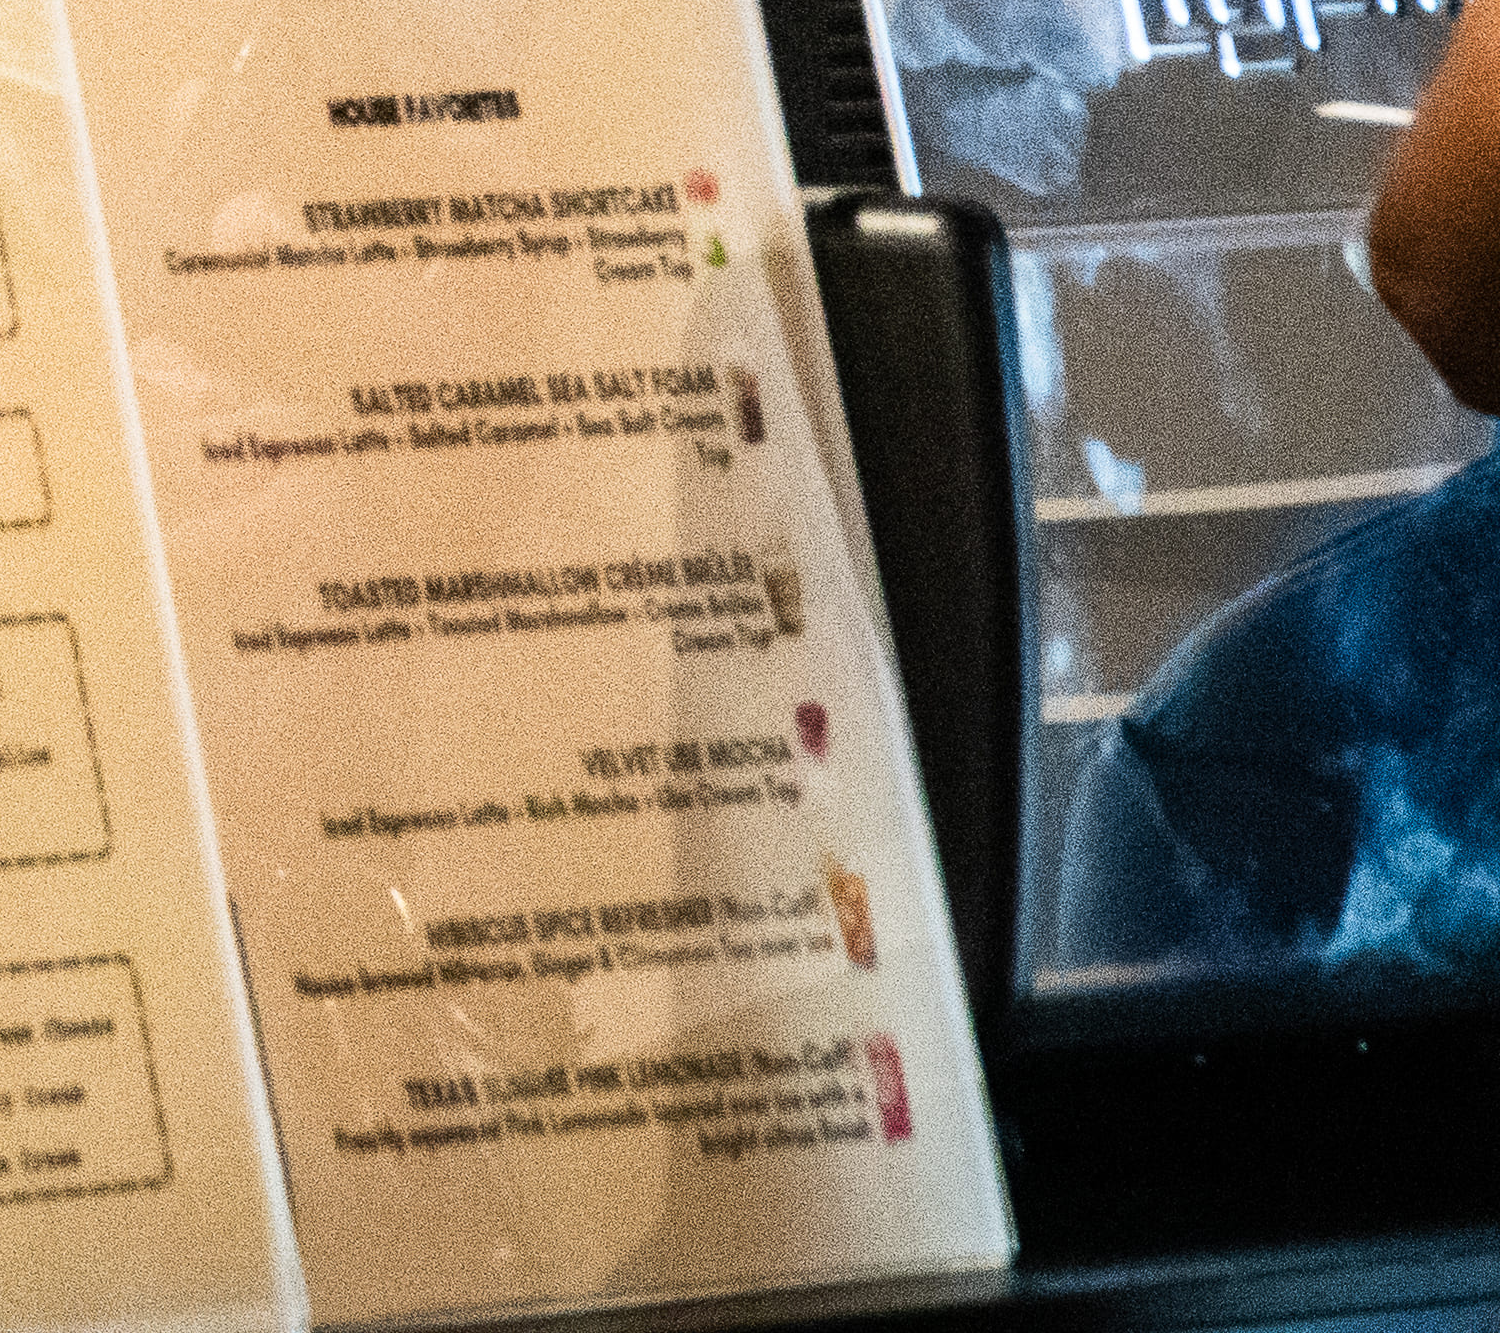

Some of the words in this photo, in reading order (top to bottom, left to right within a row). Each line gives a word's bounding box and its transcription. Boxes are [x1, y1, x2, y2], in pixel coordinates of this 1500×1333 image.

[328, 96, 400, 127] HOUSE
[406, 90, 521, 123] FAVORITES
[303, 197, 442, 233] STRAWBERRY
[449, 191, 546, 224] MATCHA
[552, 183, 679, 219] SHORTCAKE
[165, 244, 269, 273] Ceremonial
[277, 241, 346, 267] Matcha
[354, 239, 396, 261] Latte
[413, 233, 515, 262] Strawberry
[519, 229, 569, 258] Syrup
[586, 224, 684, 253] Strawberry
[595, 259, 655, 282] Cream
[660, 256, 693, 282] Top
[350, 383, 433, 415] SALTED
[436, 378, 544, 412] CARAMEL
[546, 373, 588, 404] SEA
[593, 369, 646, 401] SALT
[651, 364, 718, 396] FOAM
[342, 428, 389, 453] Latte
[408, 420, 471, 449] Salted
[475, 418, 557, 445] Caramel
[577, 410, 612, 437] Sea
[617, 409, 655, 434] Salt
[660, 405, 724, 431] Cream
[694, 439, 732, 470] Top
[318, 576, 421, 612] TOASTED
[425, 565, 600, 603] MARSHMALLOW
[579, 743, 657, 779] VELVET
[666, 741, 701, 772] UBE
[706, 736, 791, 768] MOCHA
[425, 912, 529, 950] HIBISCUS
[533, 908, 593, 943] SPICE
[599, 897, 712, 935] REFRESHER
[405, 1076, 478, 1109] TEXAS
